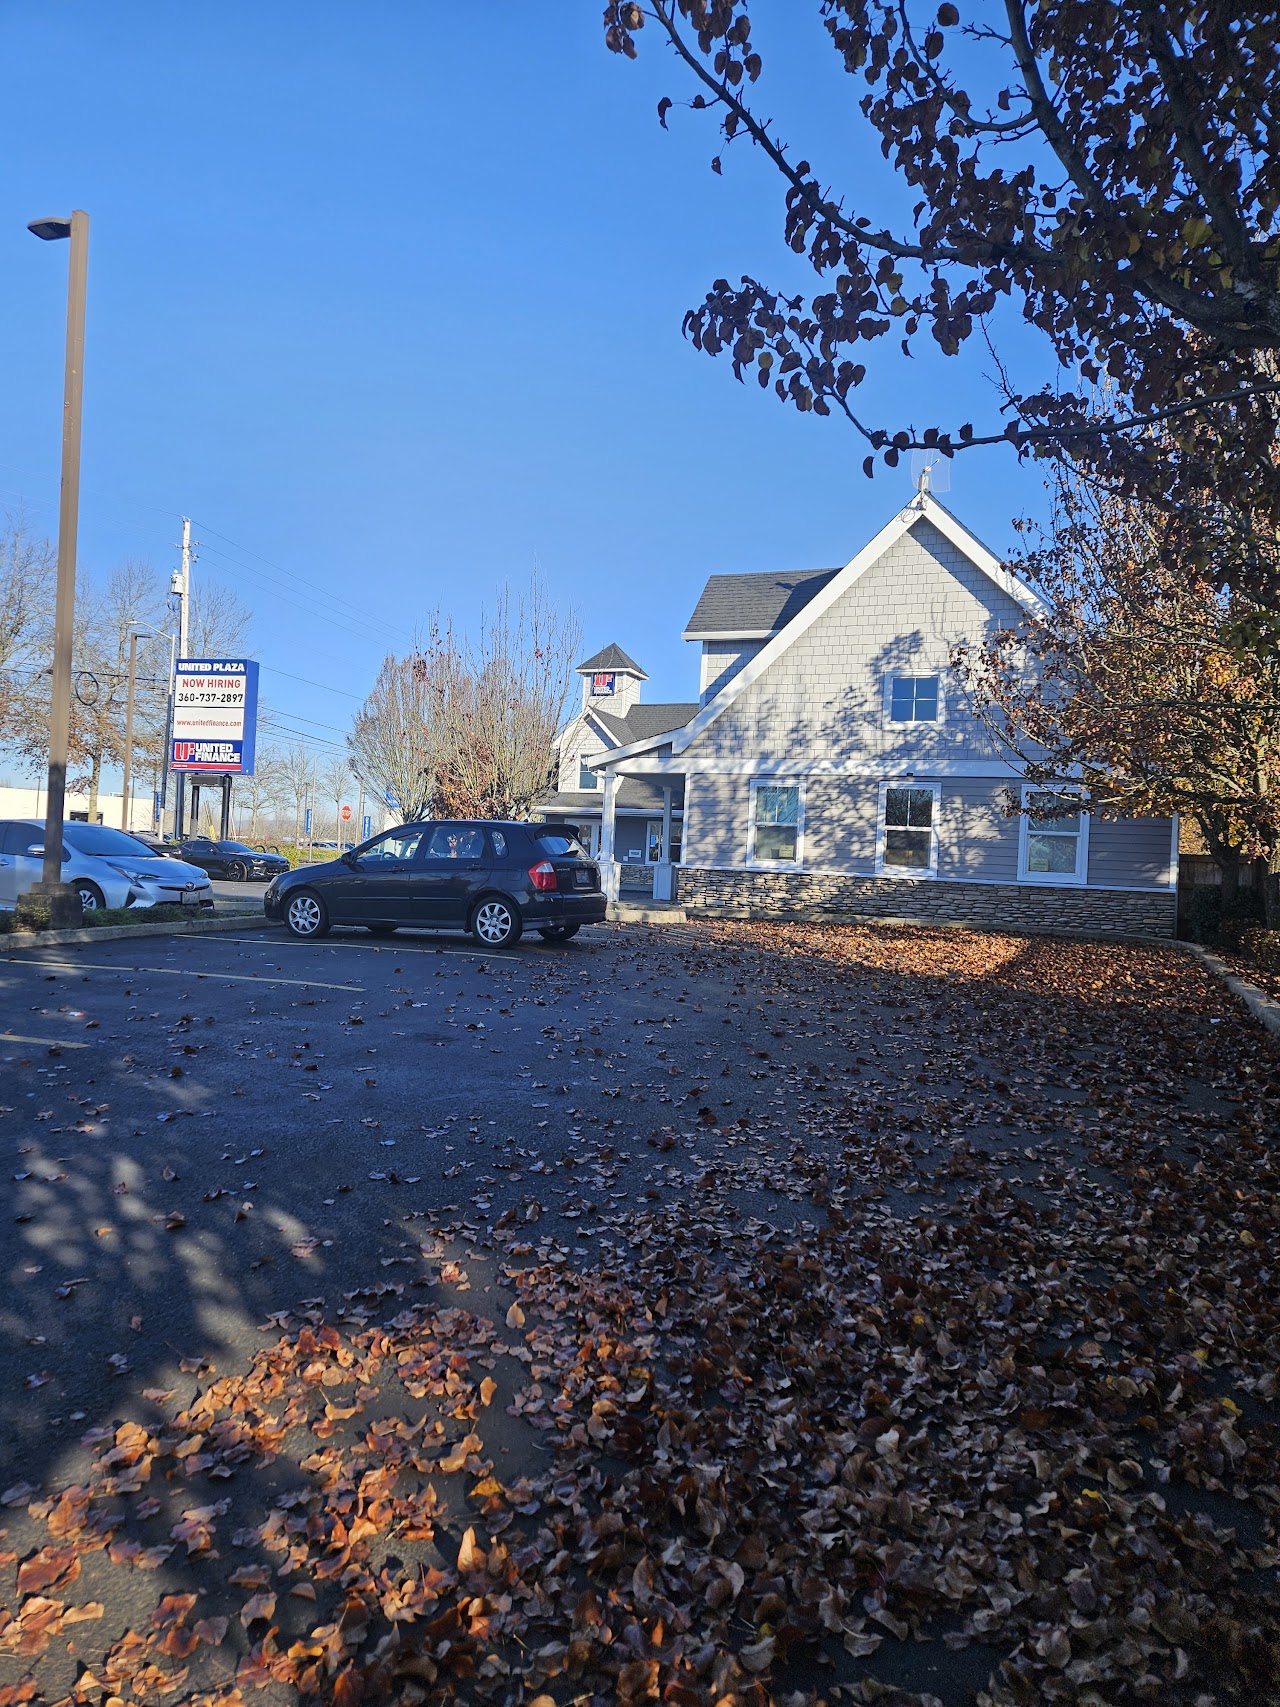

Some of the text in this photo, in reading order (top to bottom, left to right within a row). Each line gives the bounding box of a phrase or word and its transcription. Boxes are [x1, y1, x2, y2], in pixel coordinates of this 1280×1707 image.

[178, 663, 245, 672] UNITED PLAZA
[182, 678, 241, 688] NOW HIRING
[178, 693, 244, 703] 360-737-2897
[176, 719, 242, 728] www.unitedfinance.com
[195, 743, 234, 752] UNITED
[195, 752, 241, 763] FINANCE
